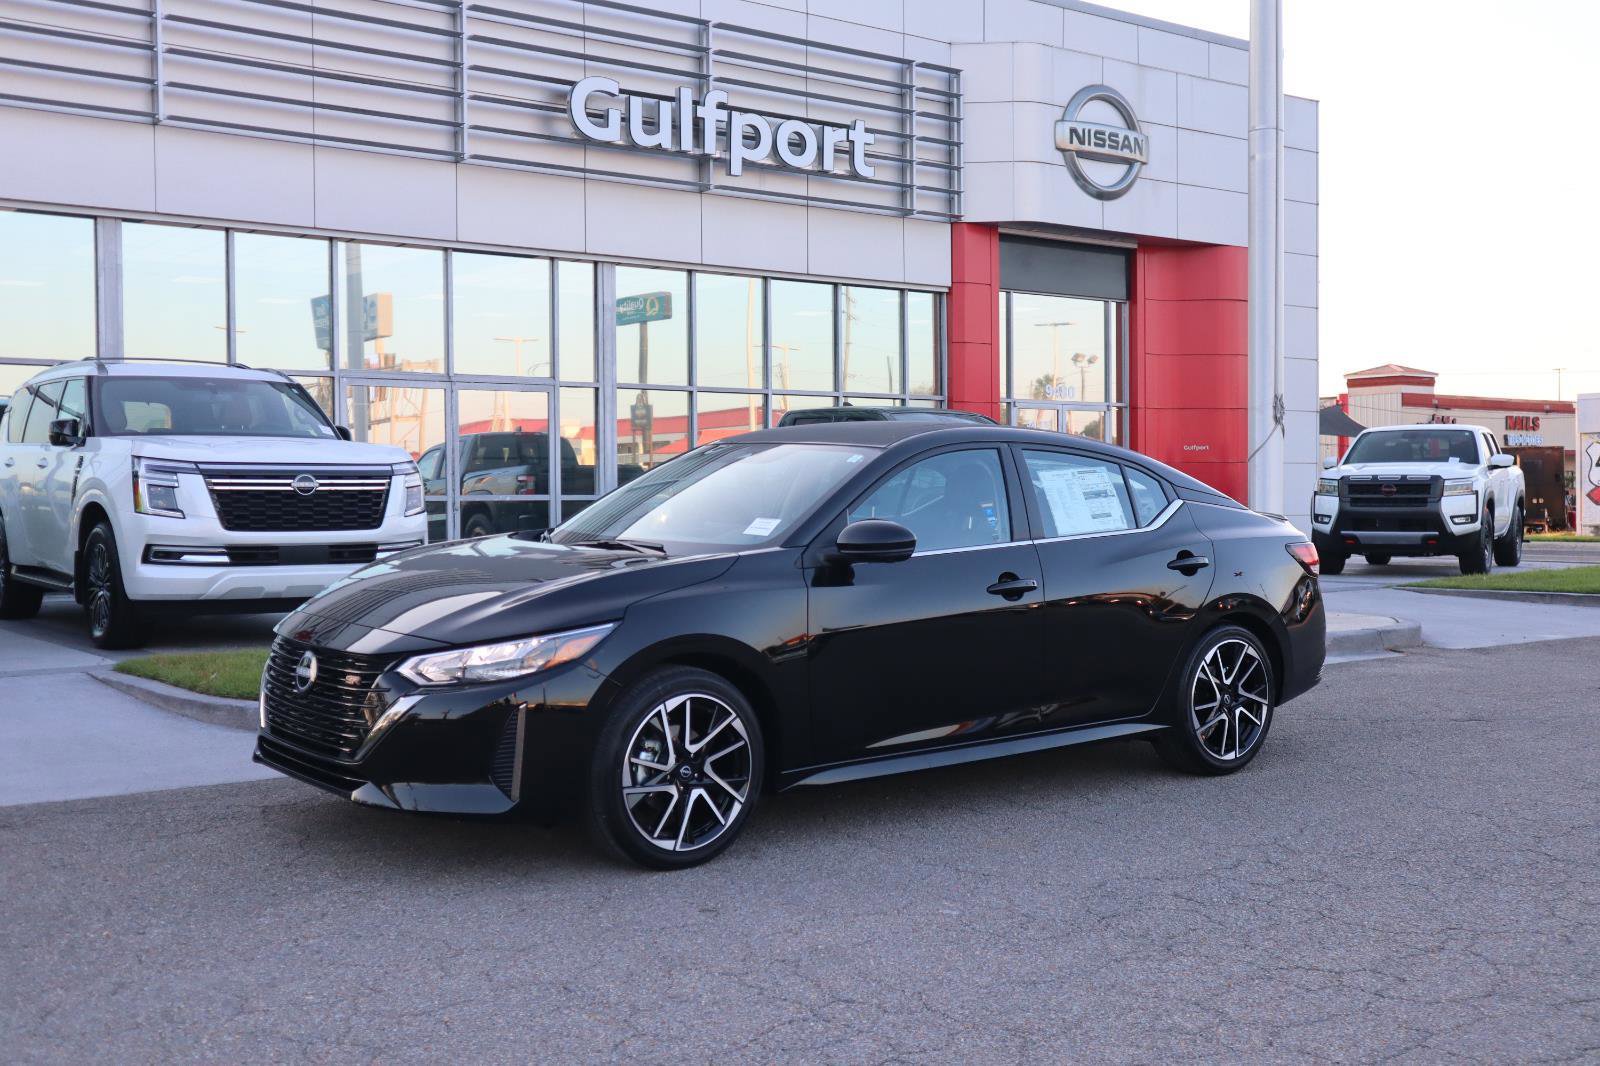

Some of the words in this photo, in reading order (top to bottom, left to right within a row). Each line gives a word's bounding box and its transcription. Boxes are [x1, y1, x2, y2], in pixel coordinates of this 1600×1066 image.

[567, 76, 876, 177] Gulfport
[1069, 127, 1144, 156] NISSAN
[1505, 415, 1540, 431] NAILS
